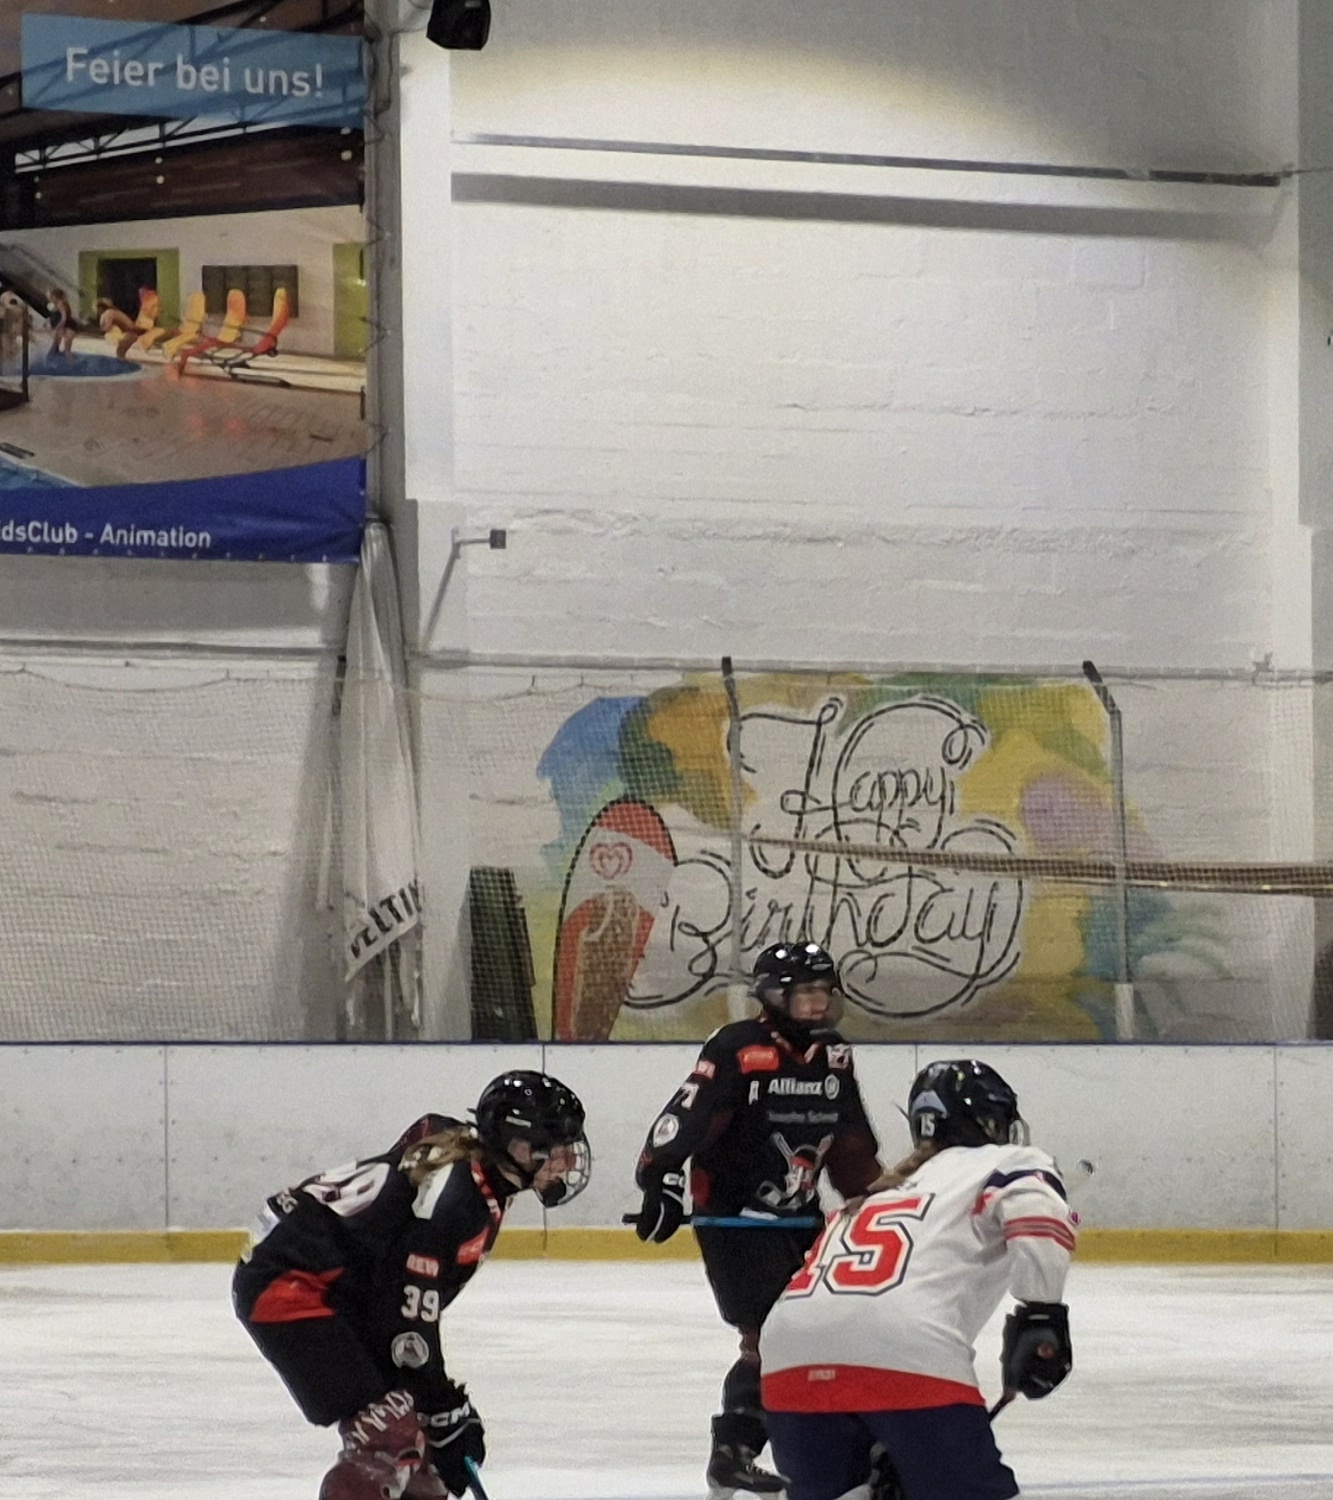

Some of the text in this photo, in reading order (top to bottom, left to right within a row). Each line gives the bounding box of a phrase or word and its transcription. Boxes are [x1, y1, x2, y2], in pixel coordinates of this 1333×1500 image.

[65, 47, 323, 97] Feier bei uns!
[0, 519, 78, 544] dsClub
[100, 523, 211, 548] Animation
[400, 1285, 440, 1322] 39
